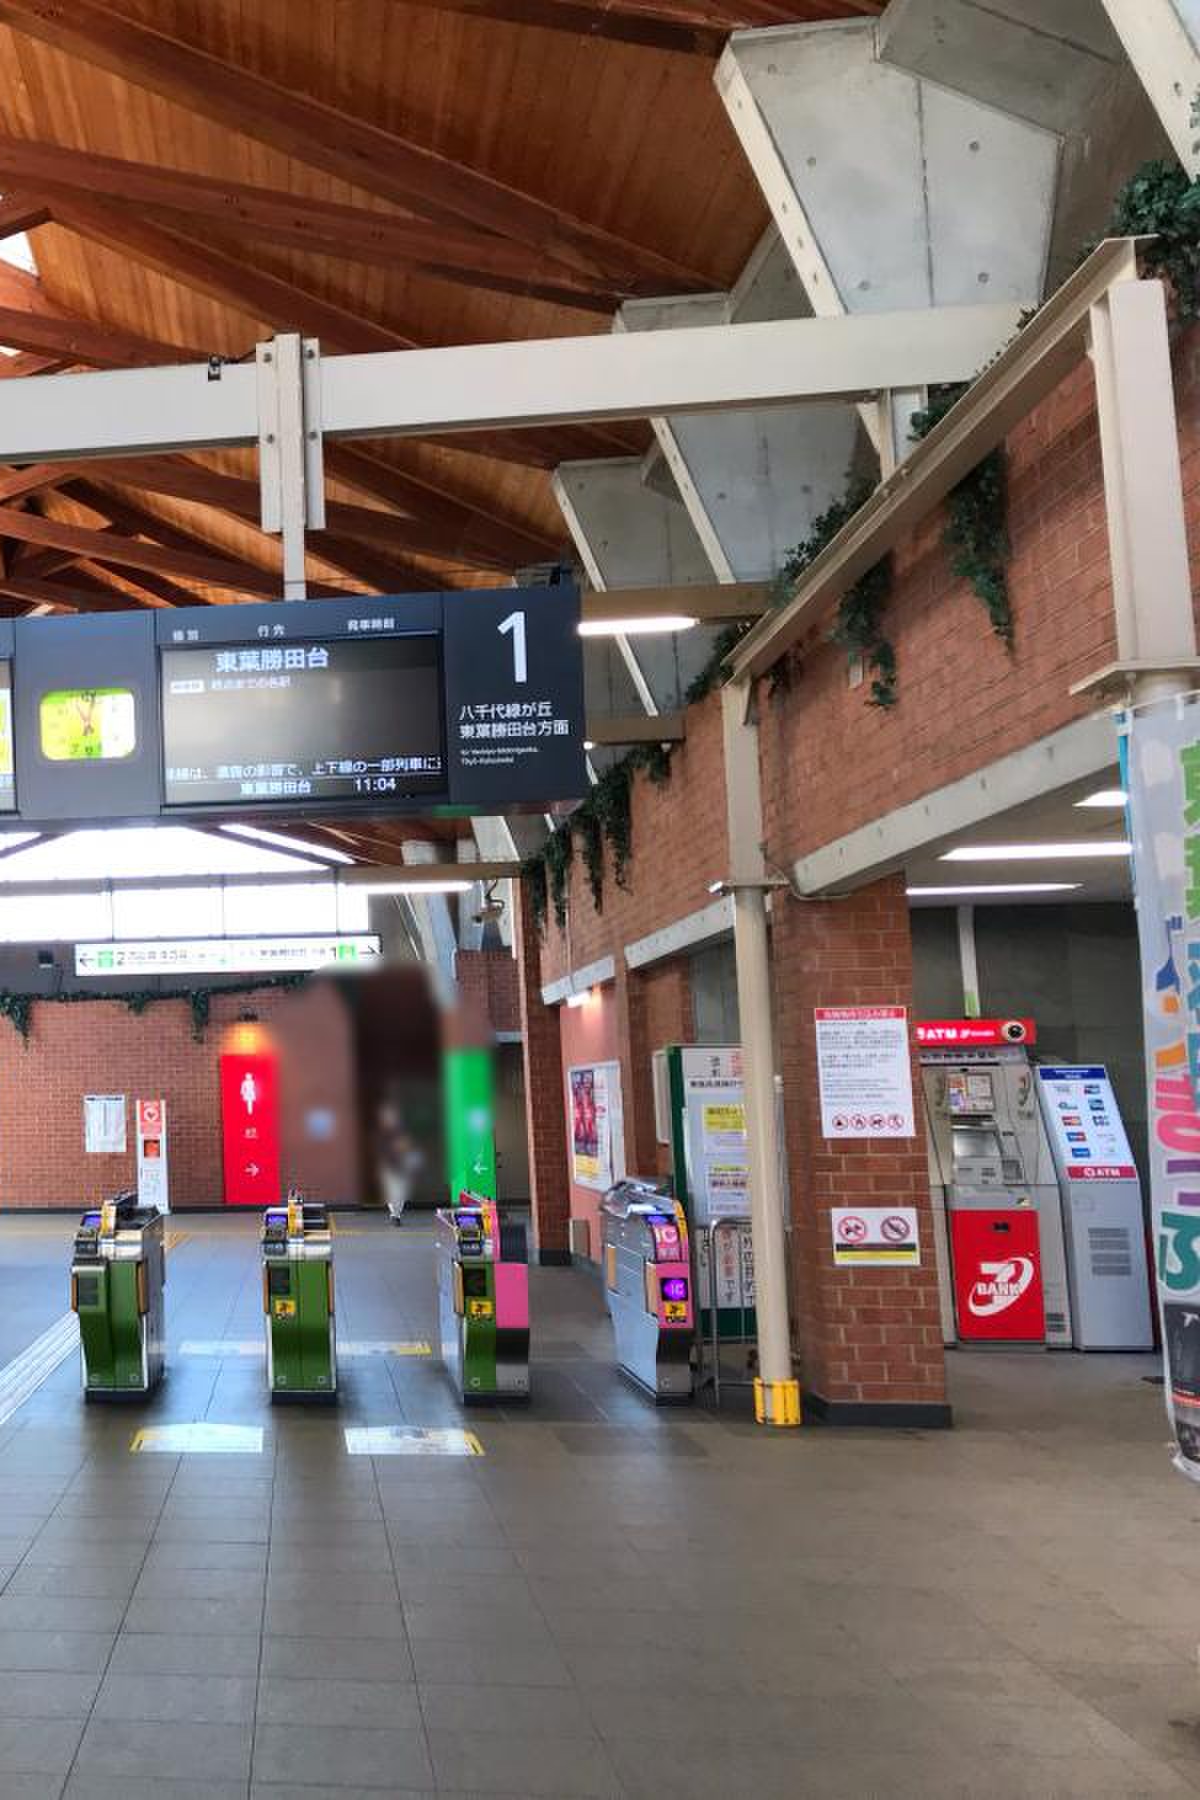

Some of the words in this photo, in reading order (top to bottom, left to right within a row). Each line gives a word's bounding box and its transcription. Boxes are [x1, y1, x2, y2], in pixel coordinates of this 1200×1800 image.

[497, 611, 527, 683] 1
[216, 647, 329, 672] 東葉勝田台
[459, 702, 552, 720] 八千代緑が丘
[459, 719, 569, 738] 東葉勝田台方面
[355, 777, 397, 791] 11:04
[654, 1225, 678, 1243] IC
[976, 1282, 1020, 1297] BANK
